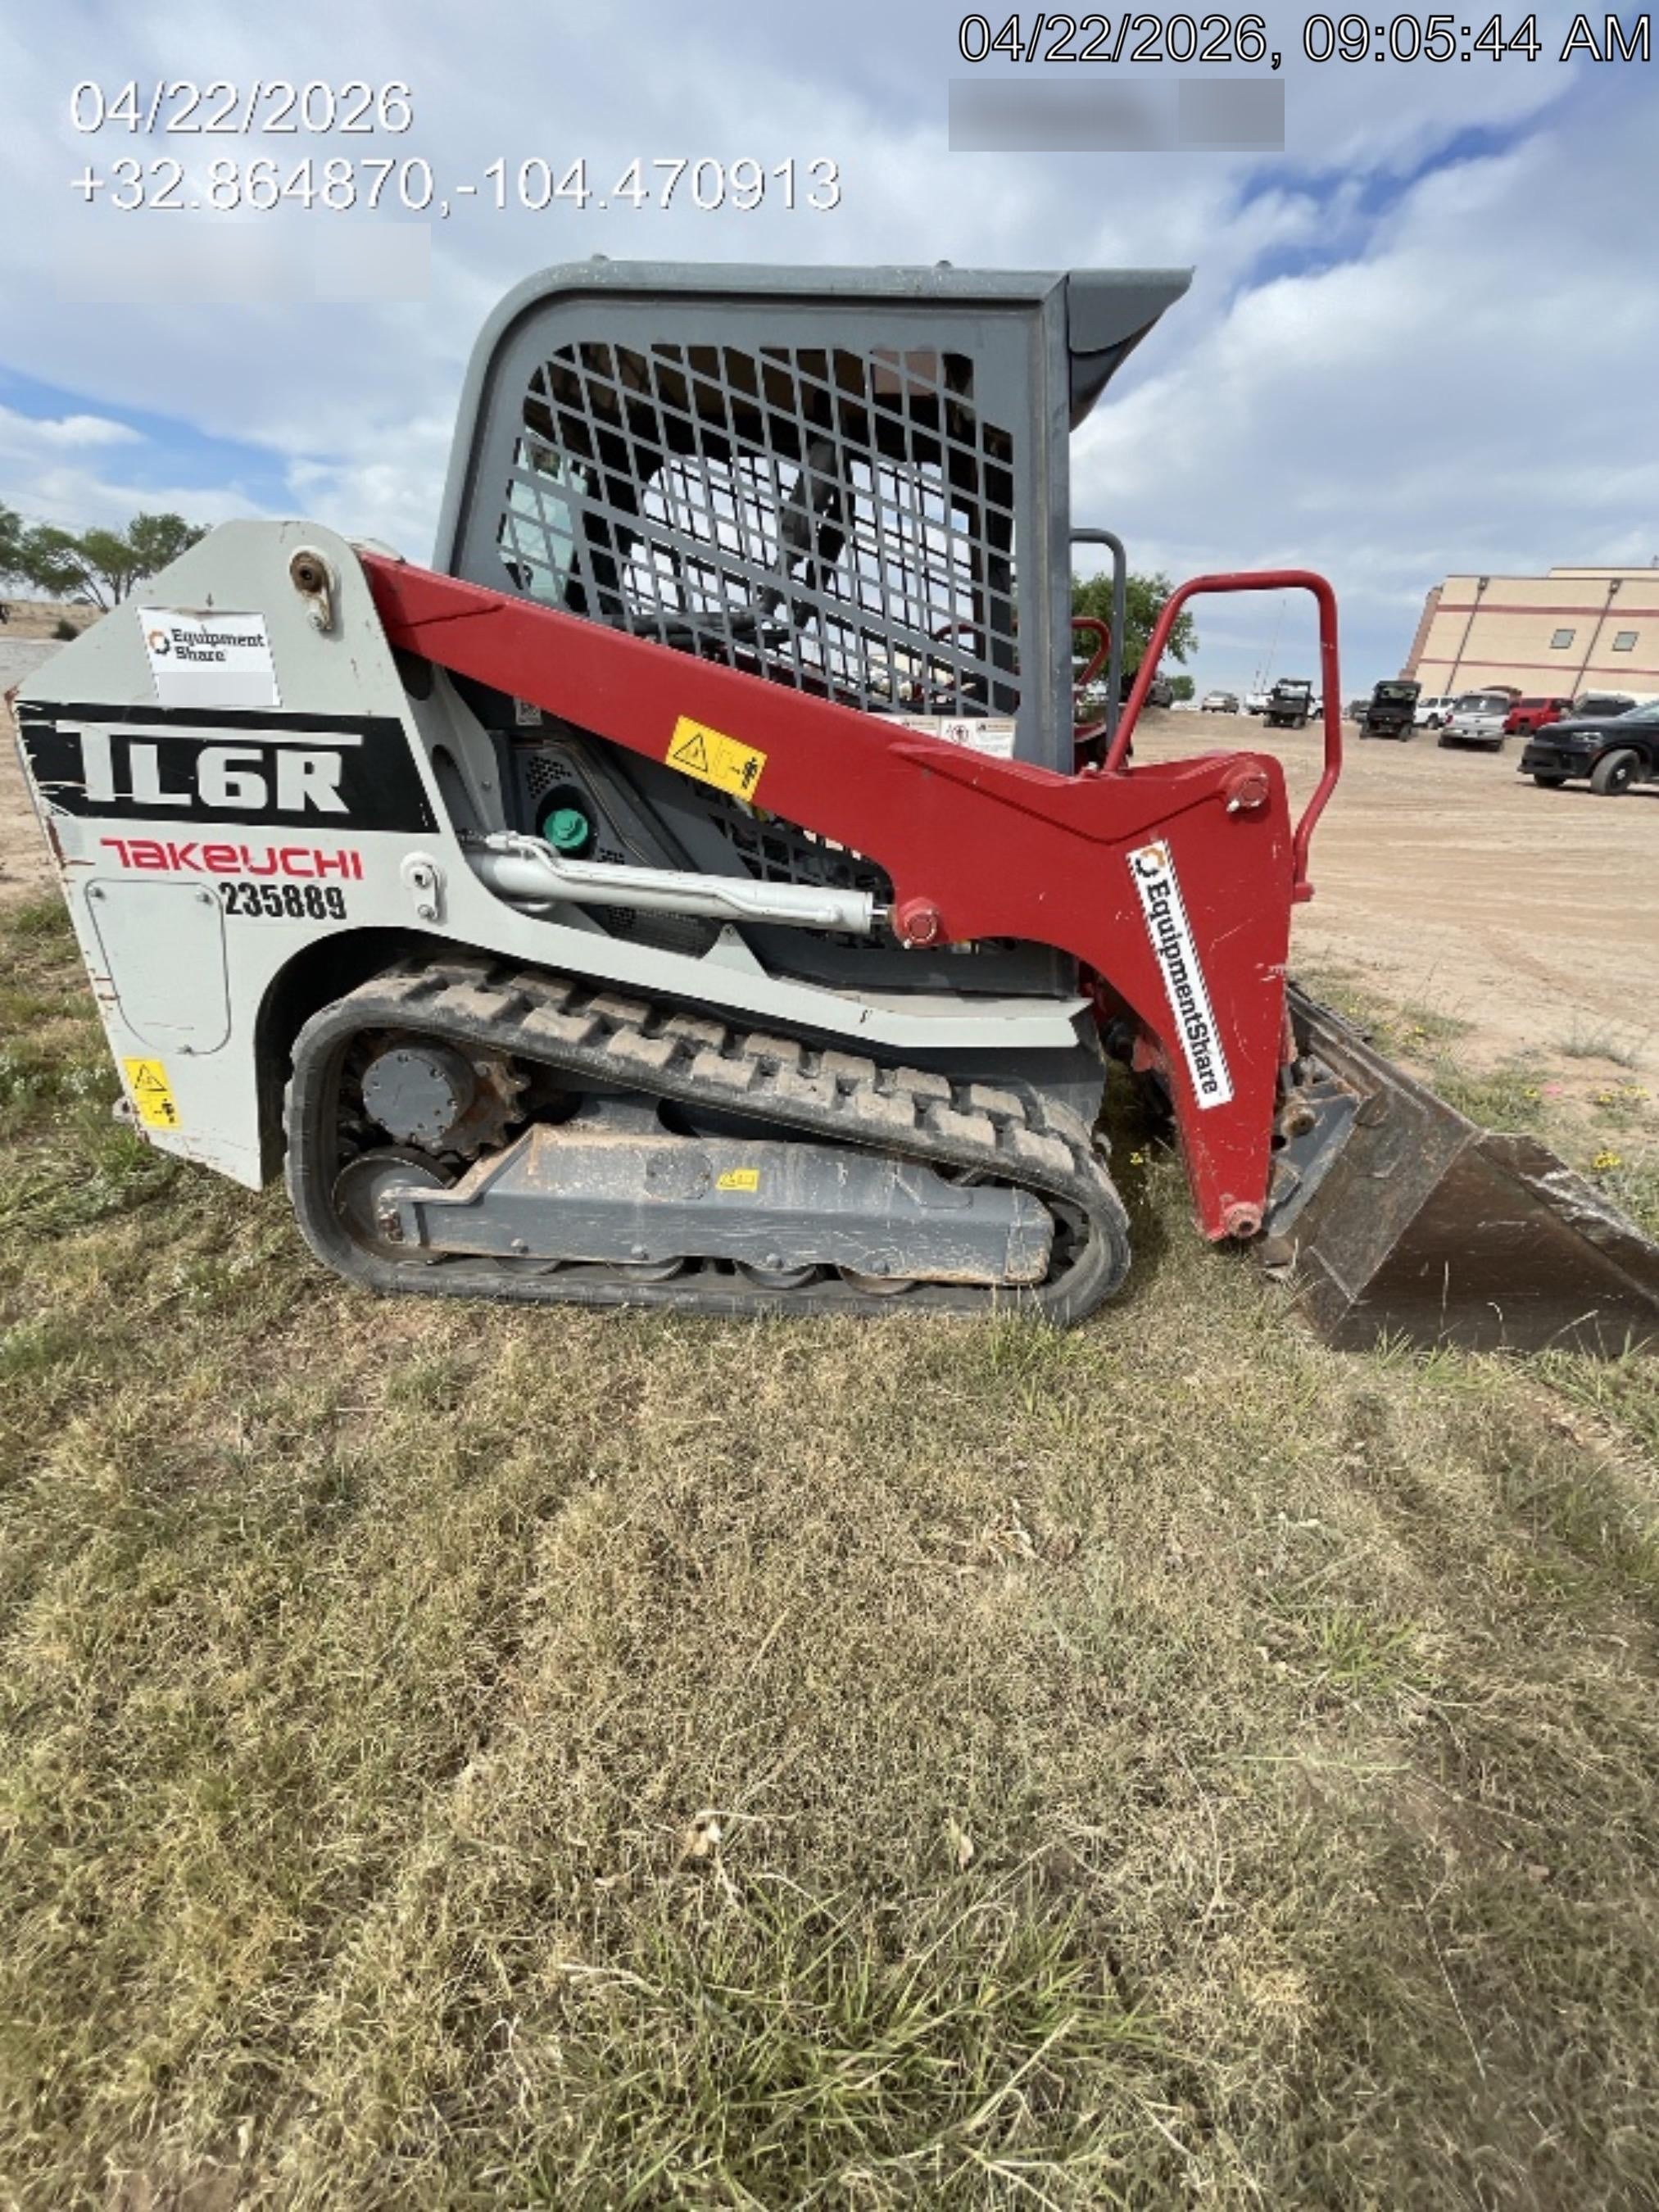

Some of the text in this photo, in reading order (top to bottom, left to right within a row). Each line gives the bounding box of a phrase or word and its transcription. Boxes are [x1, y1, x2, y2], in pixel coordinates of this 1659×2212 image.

[171, 628, 266, 647] Equipment
[175, 646, 227, 662] Share
[56, 719, 363, 814] TL6R
[218, 881, 347, 920] 235889
[1147, 878, 1218, 1096] EquipmentShare
